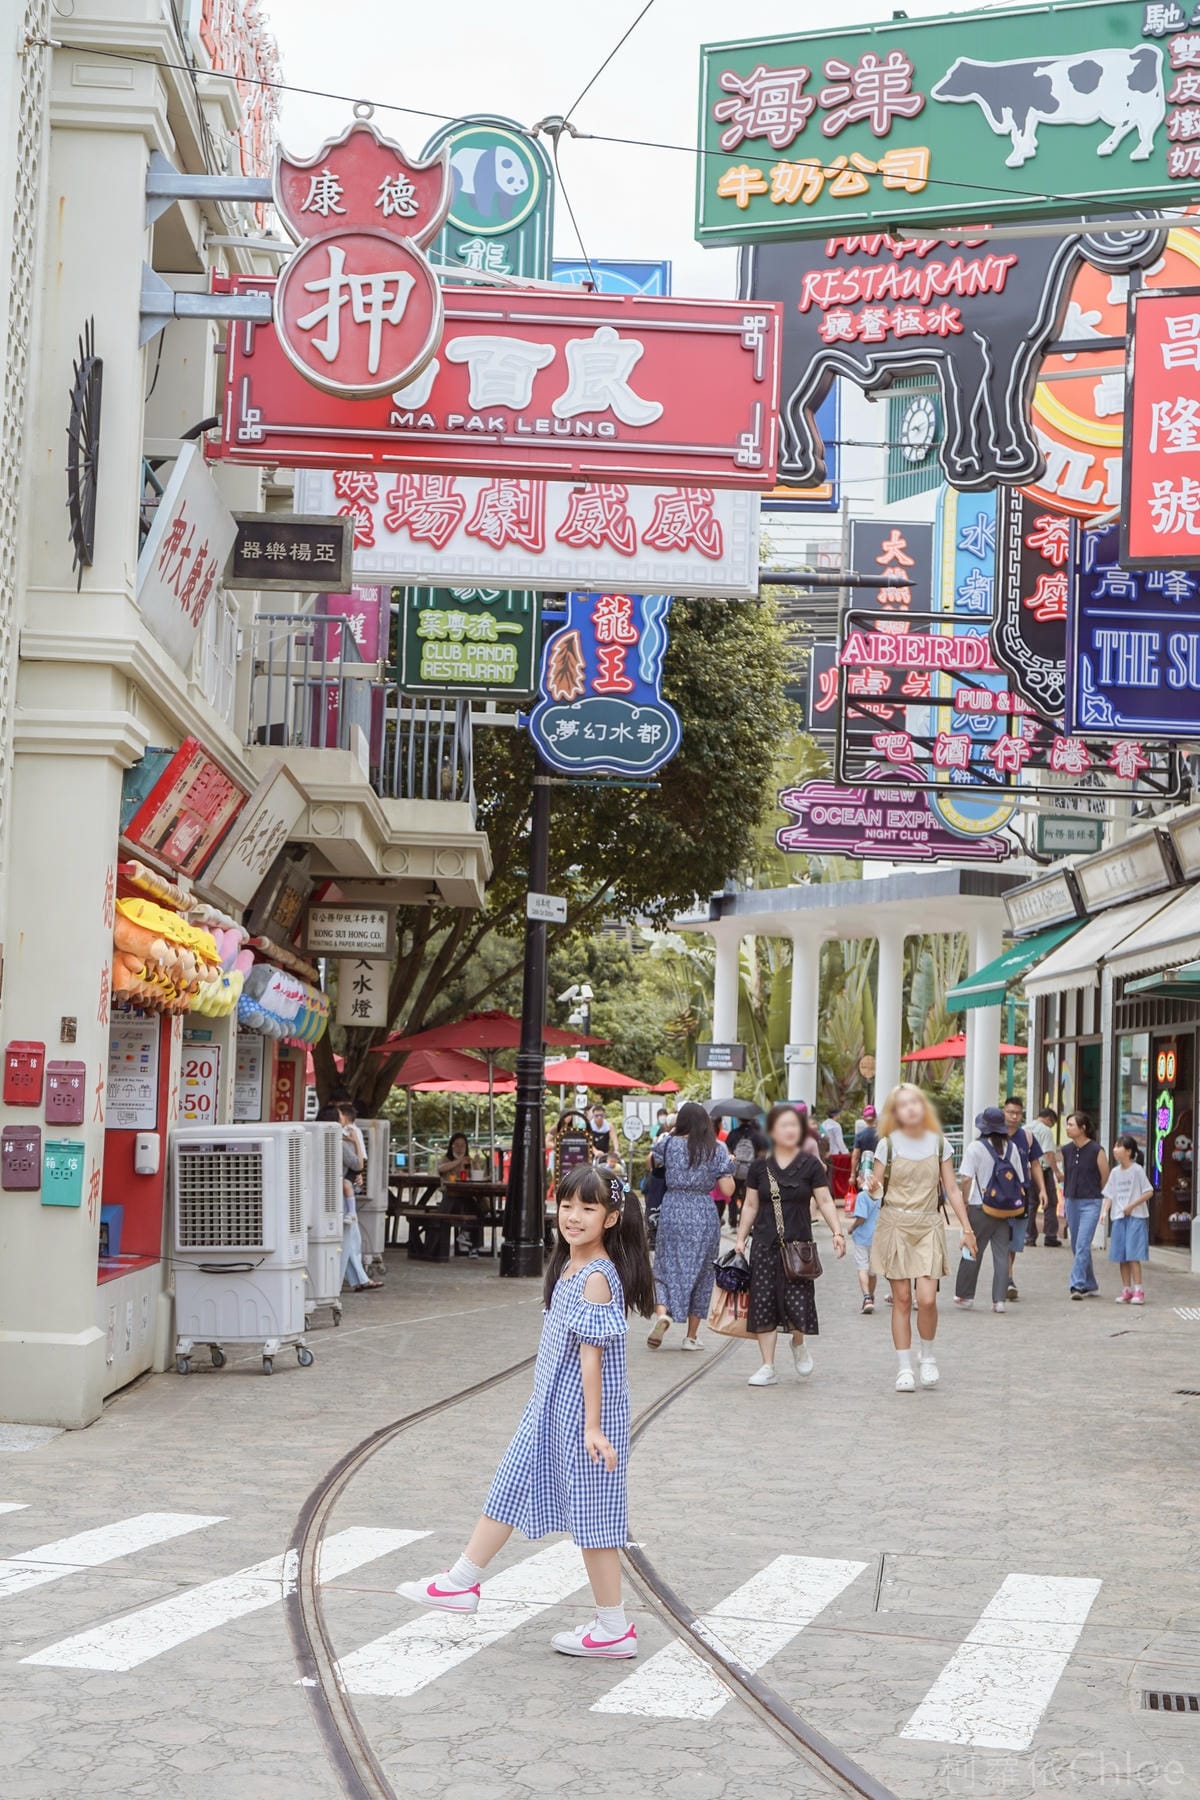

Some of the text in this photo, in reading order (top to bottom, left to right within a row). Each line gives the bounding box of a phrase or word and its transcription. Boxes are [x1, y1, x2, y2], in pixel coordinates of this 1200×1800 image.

[1143, 3, 1200, 36] 馳
[712, 49, 926, 151] 海洋
[717, 146, 931, 209] 牛奶公司
[800, 254, 1018, 312] RESTAURANT
[297, 245, 416, 375] 押
[392, 325, 664, 428] 百良
[390, 411, 617, 437] MA PAK LEUNG
[1027, 515, 1069, 622] 茶座
[424, 643, 514, 662] CLUB PANDA
[592, 594, 639, 693] 龍王
[423, 661, 516, 680] RESTAURANT
[1095, 629, 1160, 687] THE
[956, 689, 993, 711] PUB
[996, 691, 1011, 711] &
[555, 718, 662, 745] 夢幻水都
[873, 787, 916, 802] NEW
[810, 806, 882, 829] OCEAN
[865, 829, 929, 842] NIGHT CLUB
[313, 928, 333, 939] KONG
[348, 930, 369, 940] HONG
[356, 941, 385, 950] MERCHANT
